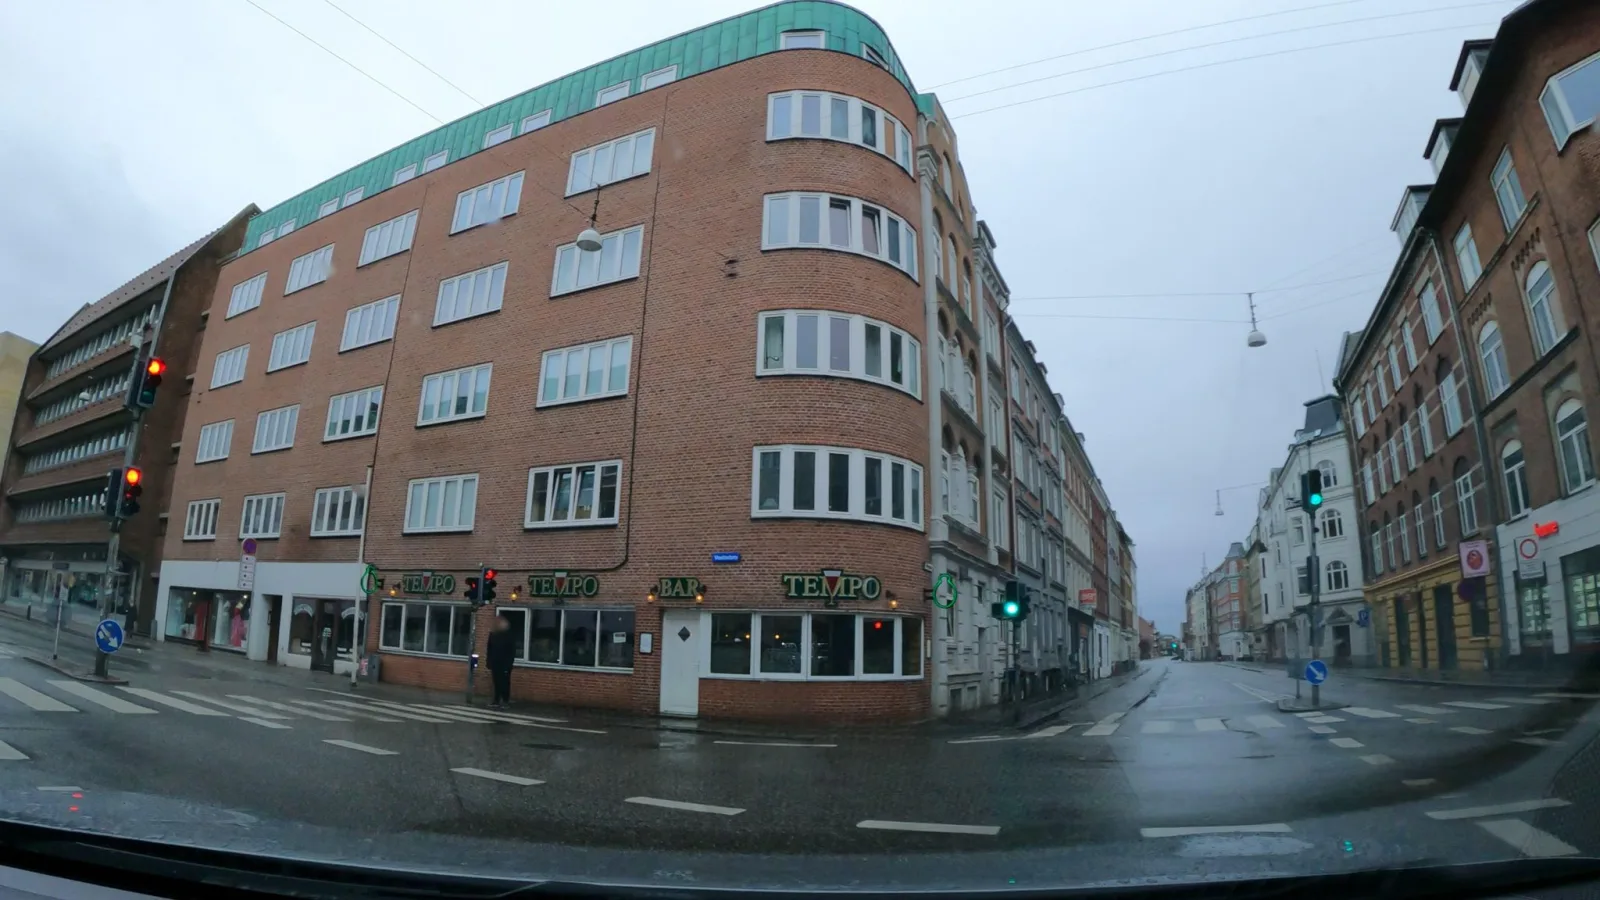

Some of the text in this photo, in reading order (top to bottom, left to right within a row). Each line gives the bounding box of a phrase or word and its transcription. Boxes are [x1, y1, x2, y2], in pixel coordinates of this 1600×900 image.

[403, 575, 455, 593] TEMPO
[529, 576, 598, 596] TEMPO
[660, 578, 698, 597] BAR
[783, 574, 880, 599] TEMPO
